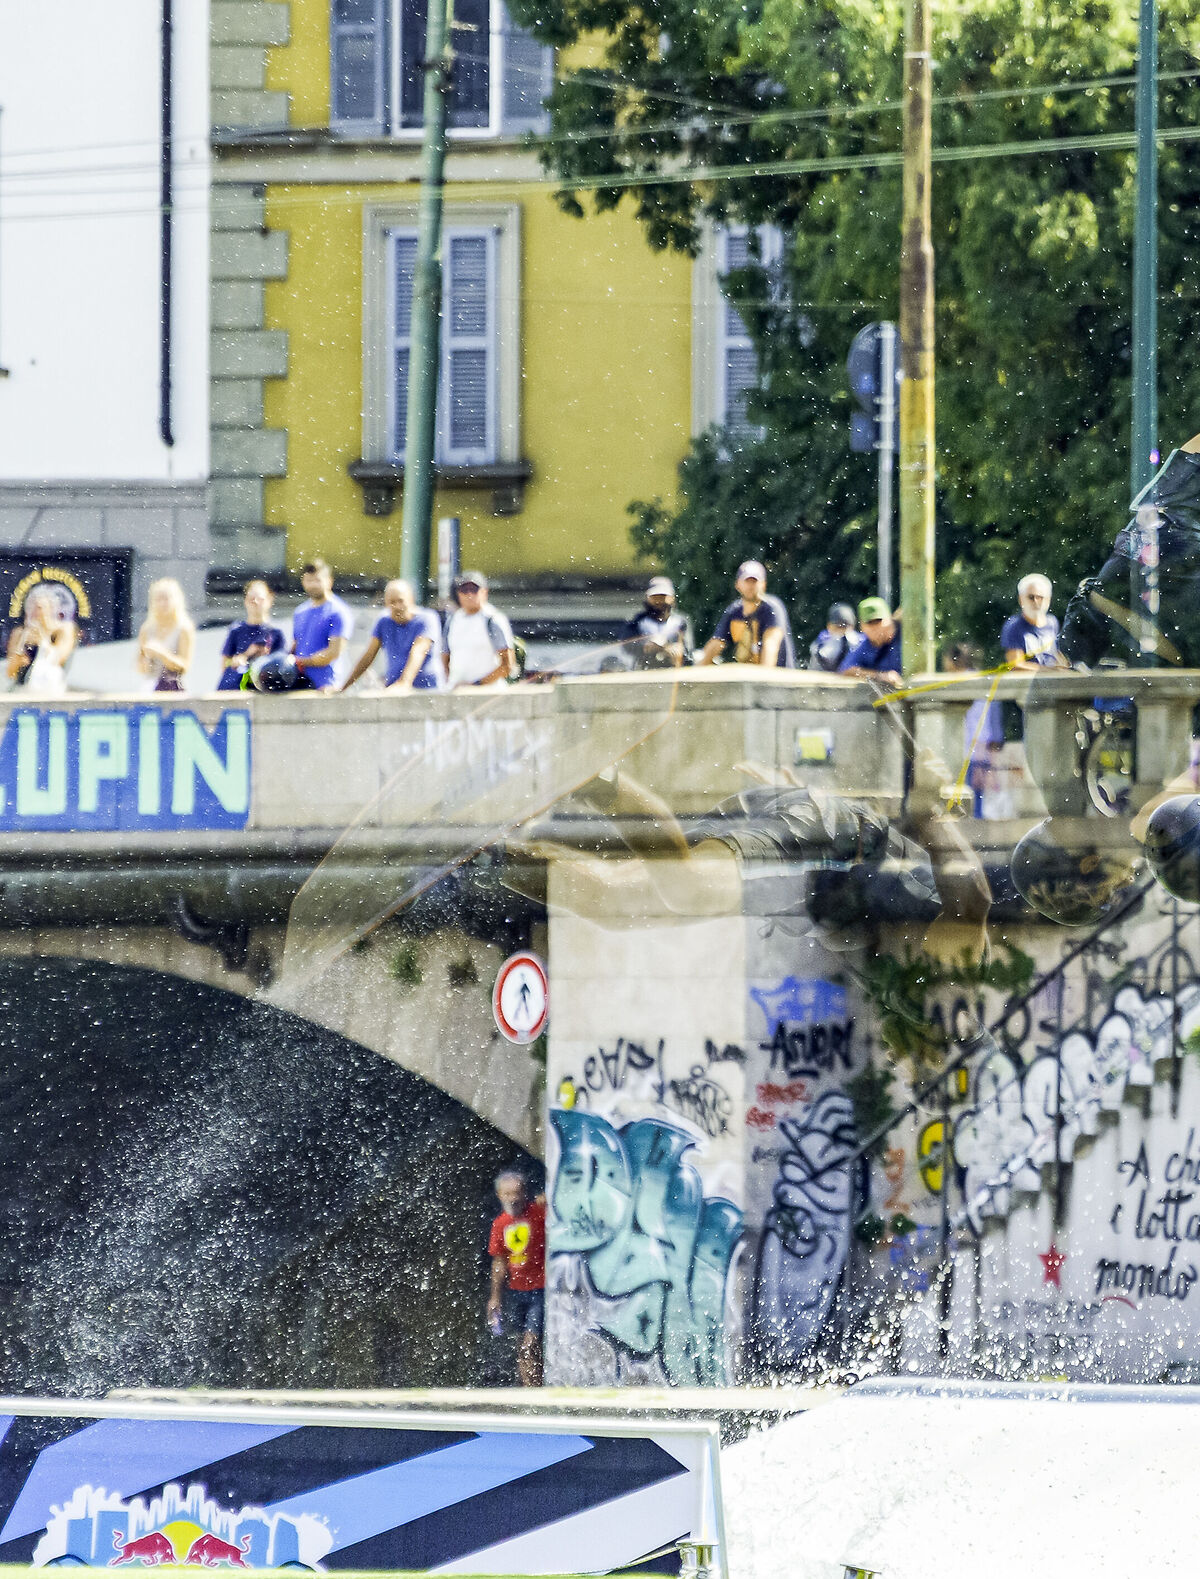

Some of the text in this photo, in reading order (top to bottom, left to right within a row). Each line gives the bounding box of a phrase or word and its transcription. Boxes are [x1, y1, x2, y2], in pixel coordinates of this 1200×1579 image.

[0, 712, 249, 816] UPIN
[1117, 1139, 1150, 1186] A
[1095, 1246, 1199, 1299] mondo
